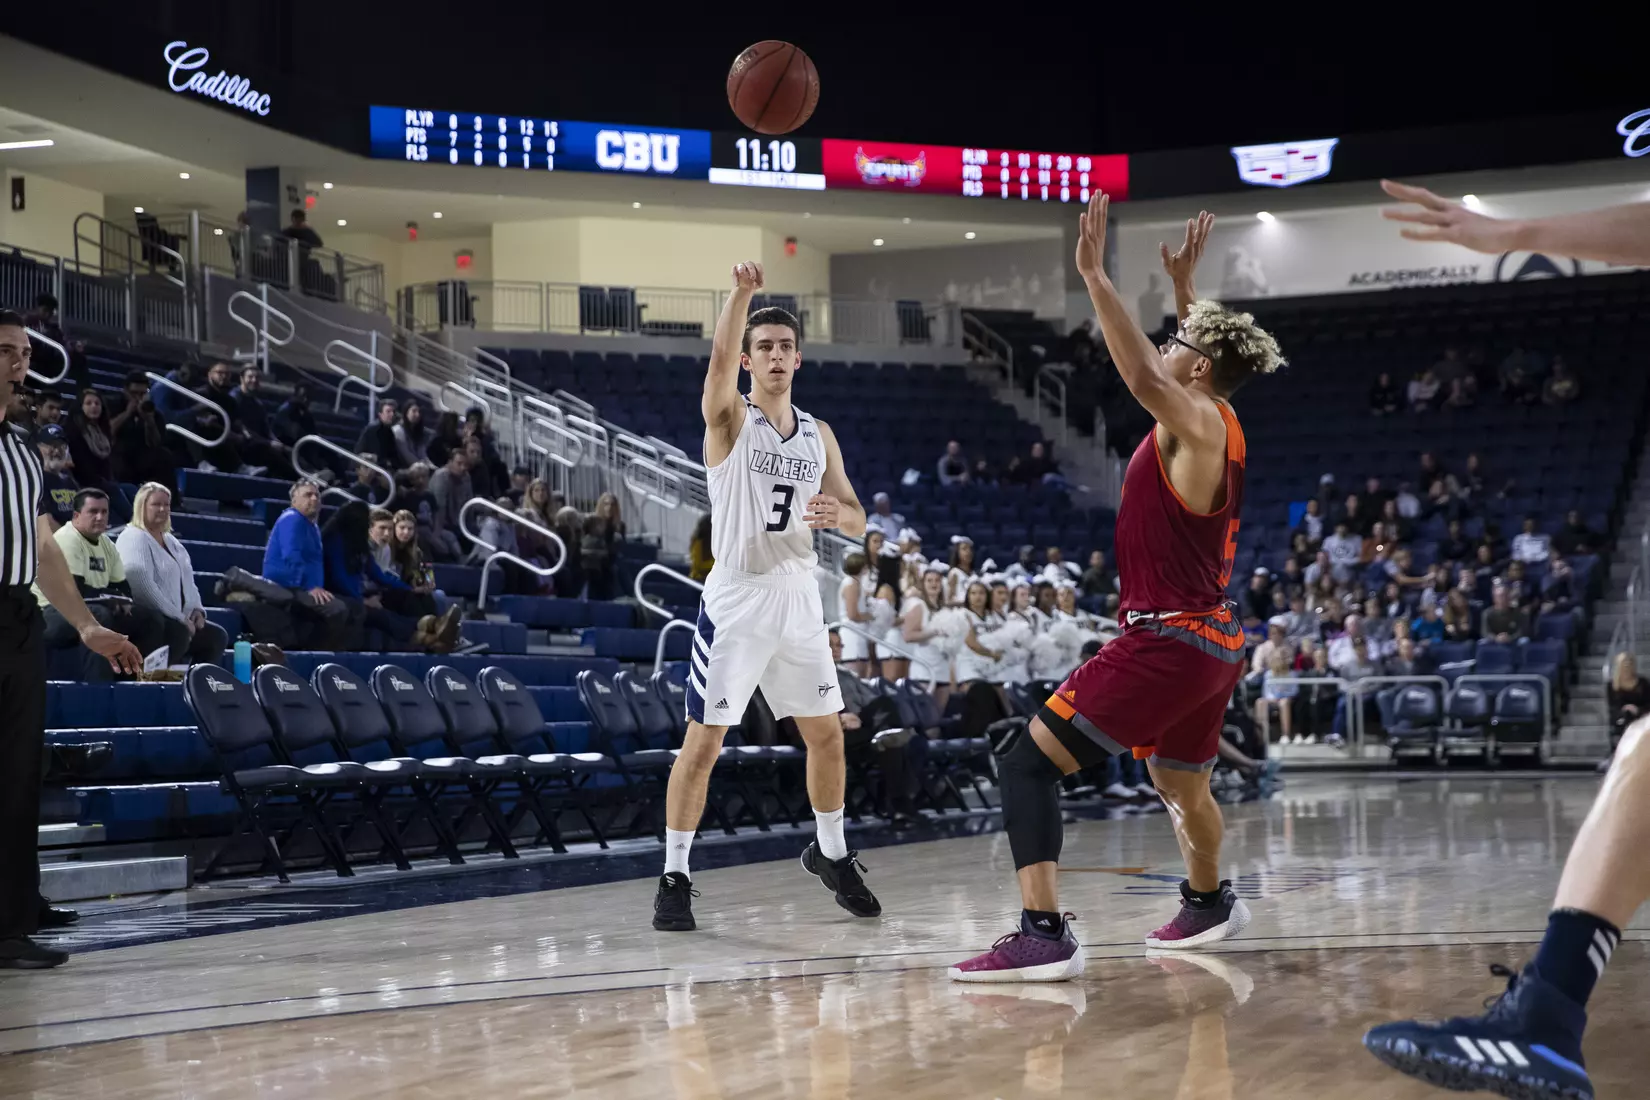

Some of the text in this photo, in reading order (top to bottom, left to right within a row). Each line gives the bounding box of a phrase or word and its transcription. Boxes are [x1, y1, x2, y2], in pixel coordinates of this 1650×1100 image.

[164, 40, 271, 116] Cadillac
[405, 109, 434, 127] PLYR
[449, 113, 458, 130] 0
[498, 117, 507, 134] 5
[520, 119, 534, 136] 12
[544, 120, 558, 137] 15
[405, 127, 555, 154] PTS 7 2 0 5 0
[405, 143, 554, 171] FLS 0 0 0 1 1
[595, 128, 680, 174] CBU
[735, 137, 796, 172] 11:10
[1349, 265, 1481, 286] ACADEMICALLY
[750, 449, 817, 483] LANCERS
[765, 483, 794, 532] 3
